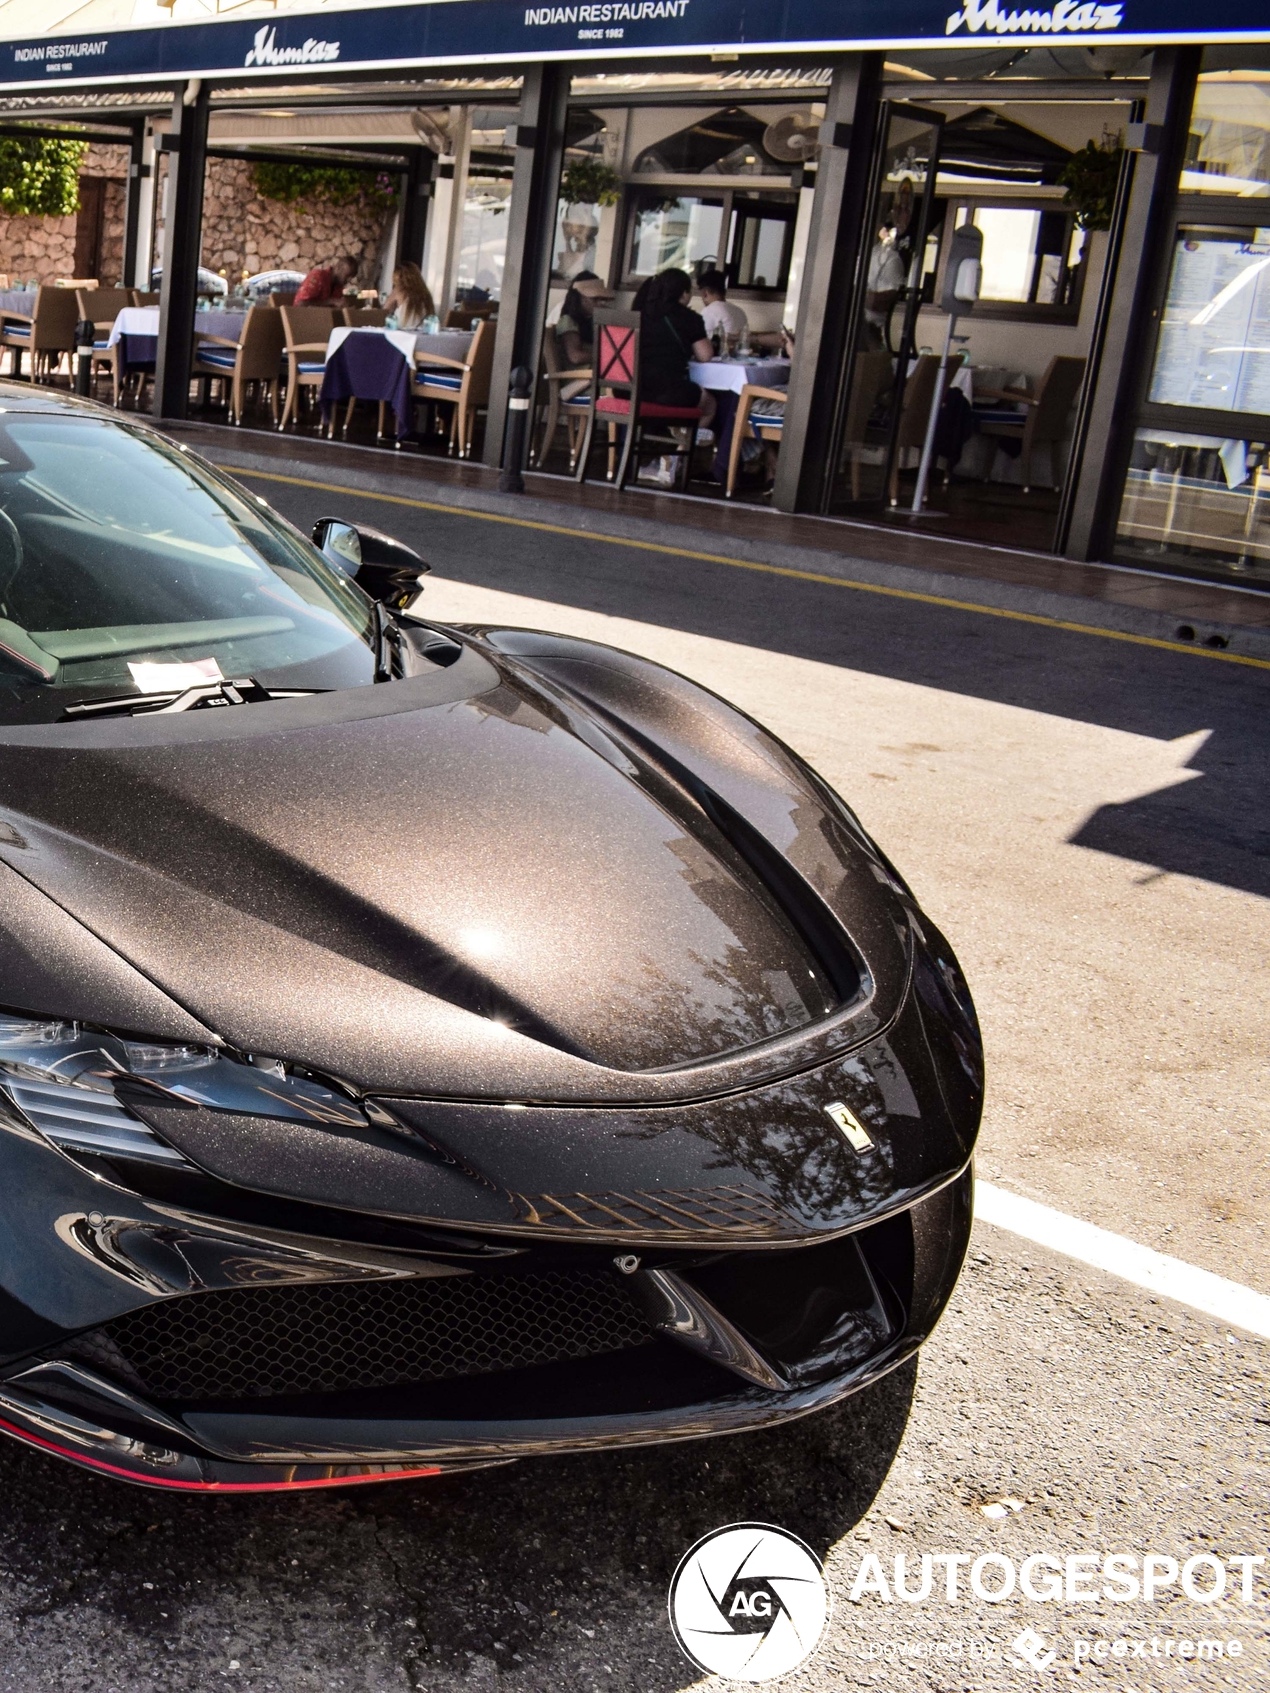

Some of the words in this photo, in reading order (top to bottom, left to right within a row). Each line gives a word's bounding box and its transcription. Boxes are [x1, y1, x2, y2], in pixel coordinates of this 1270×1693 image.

[524, 6, 578, 25] INDIAN
[579, 0, 689, 22] RESTAURANT
[945, 0, 1126, 36] Mumtaz
[244, 24, 341, 68] Mumtaz
[577, 29, 604, 39] SINCE
[605, 28, 624, 38] 1982
[14, 48, 45, 62] INDIAN
[45, 41, 108, 59] RESTAURANT
